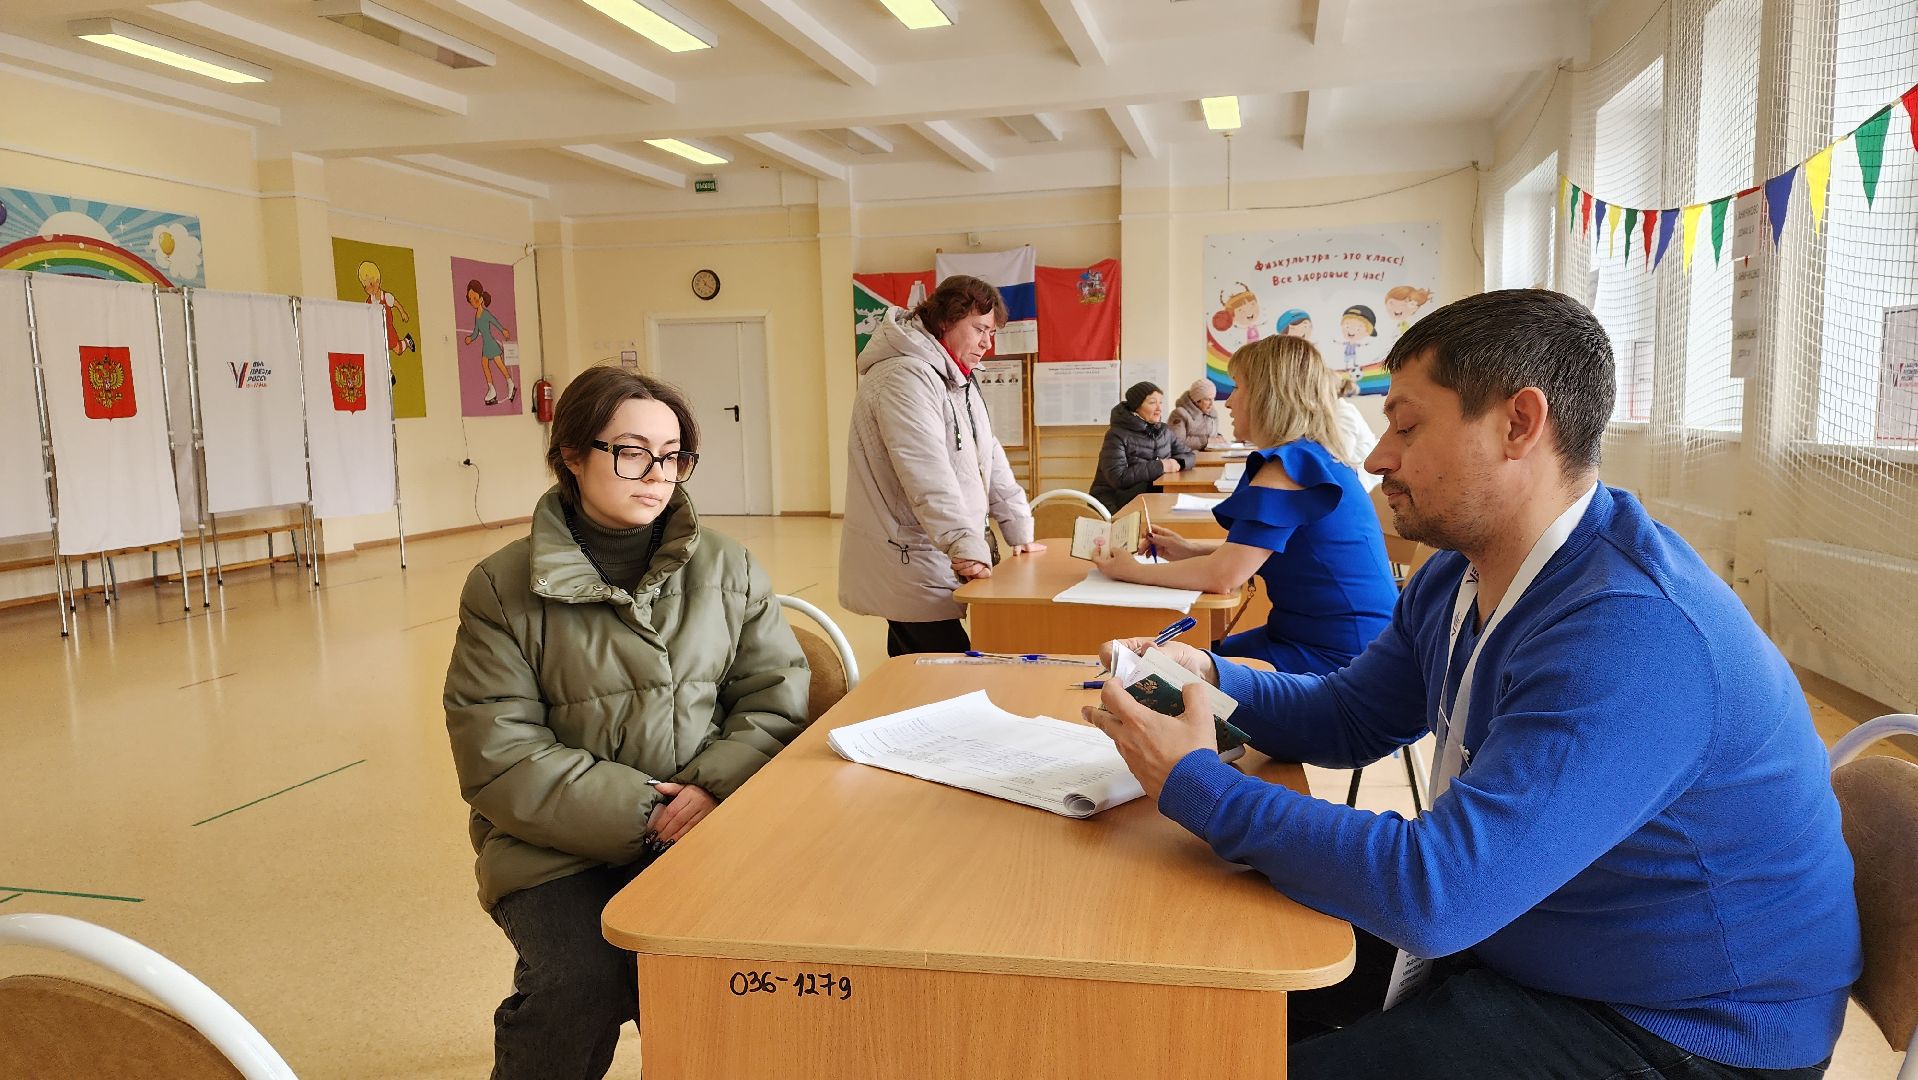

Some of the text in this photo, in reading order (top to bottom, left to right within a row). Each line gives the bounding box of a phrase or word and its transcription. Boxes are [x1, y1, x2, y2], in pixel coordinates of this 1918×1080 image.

[1254, 253, 1330, 271] Физкультура
[1343, 252, 1361, 261] это
[1366, 254, 1405, 266] класс!
[1272, 275, 1293, 286] Все
[1297, 271, 1349, 282] здоровые
[1363, 271, 1385, 282] нас!
[730, 971, 852, 1000] 036-1279
